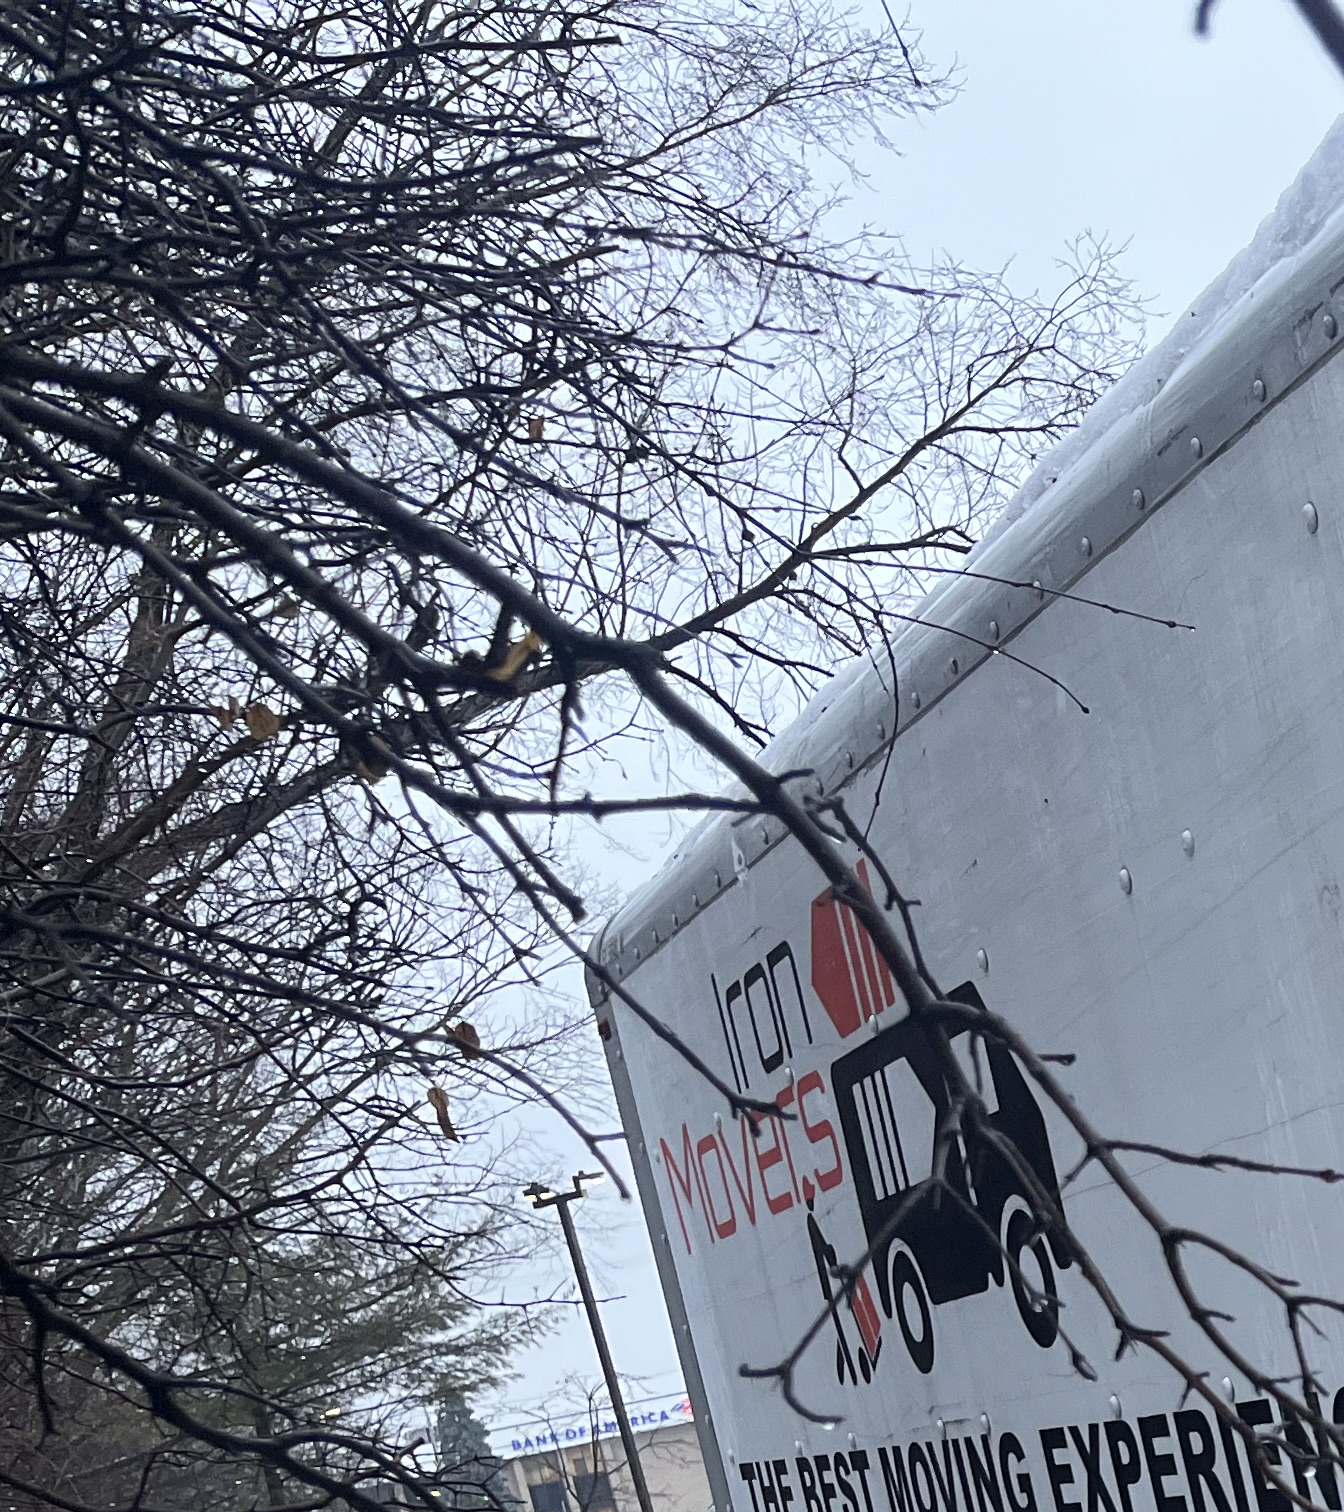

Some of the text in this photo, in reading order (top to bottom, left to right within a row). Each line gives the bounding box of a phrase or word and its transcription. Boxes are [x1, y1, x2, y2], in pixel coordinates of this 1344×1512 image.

[711, 939, 813, 1095] Iron
[660, 1070, 843, 1255] Movers
[511, 1410, 669, 1451] BANK OF AMRICA
